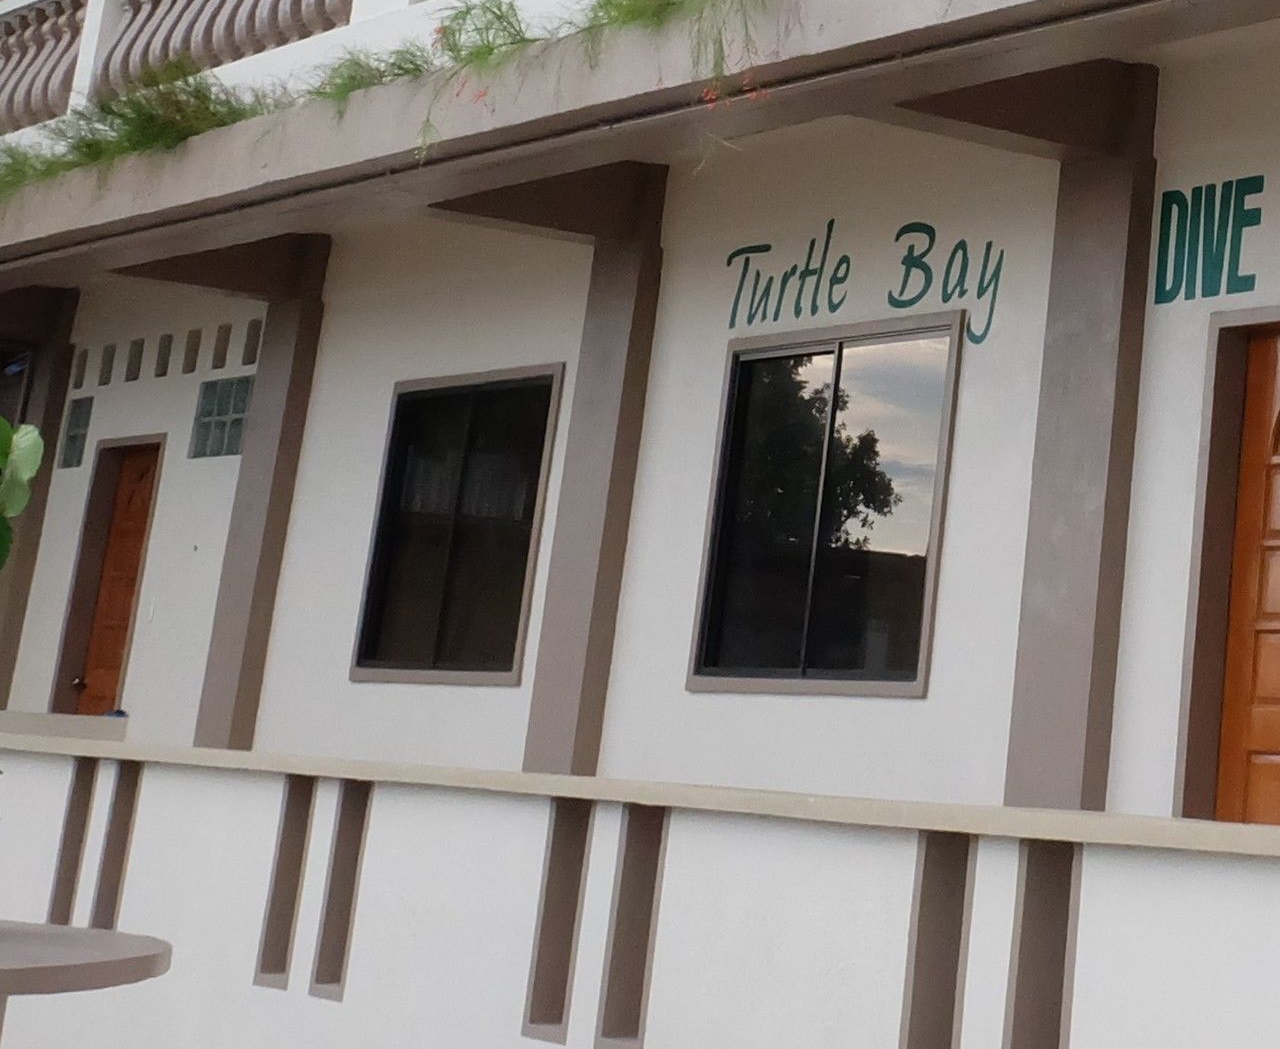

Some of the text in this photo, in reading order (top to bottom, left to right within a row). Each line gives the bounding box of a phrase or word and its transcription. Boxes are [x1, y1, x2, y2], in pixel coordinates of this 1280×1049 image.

[726, 218, 1004, 345] Turtle Bay
[1154, 174, 1264, 305] DIVE
